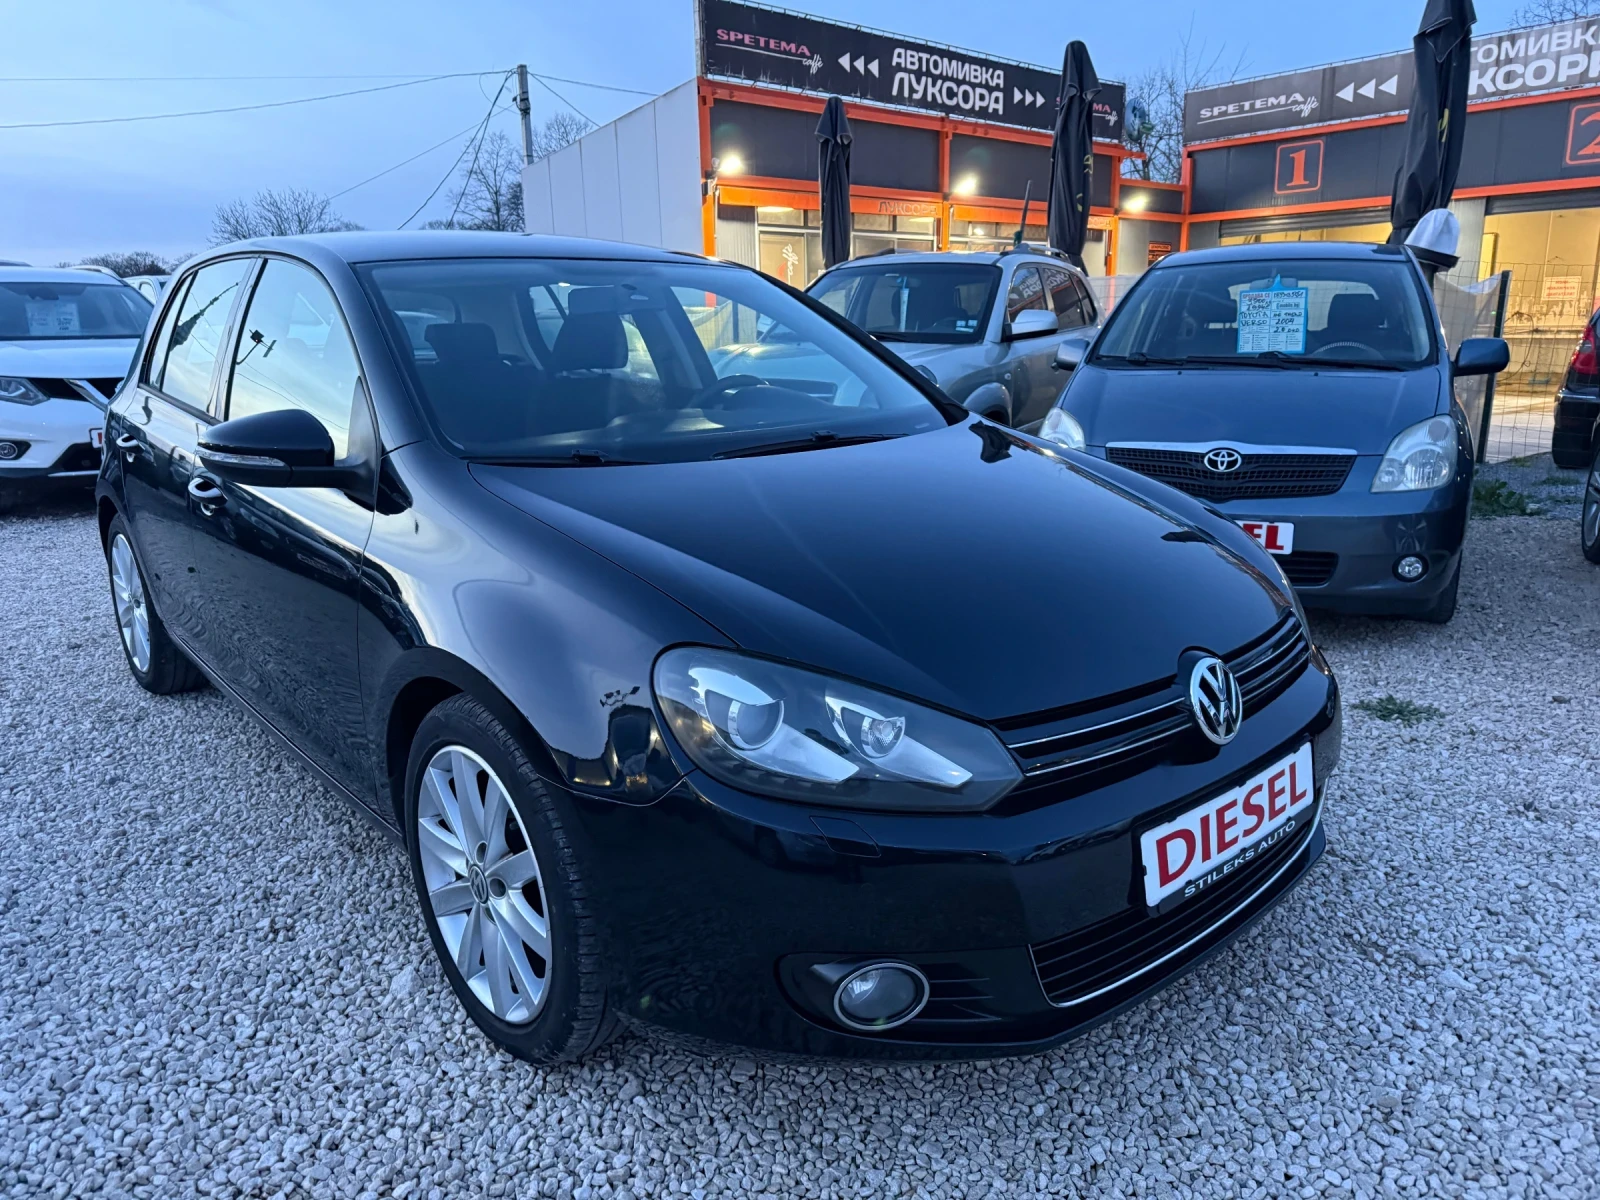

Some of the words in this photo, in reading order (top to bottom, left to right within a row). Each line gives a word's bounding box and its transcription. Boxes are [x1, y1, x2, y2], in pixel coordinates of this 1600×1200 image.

[716, 28, 812, 57] SPETEMA
[892, 47, 1004, 88] АВТОМИВКА
[891, 71, 1004, 115] ЛУКСОРА
[1199, 92, 1305, 119] SPETEMA
[1577, 110, 1600, 156] 2
[1286, 149, 1310, 188] 1
[1239, 311, 1269, 319] TOYOTA
[1155, 761, 1308, 889] DIESEL
[1184, 848, 1255, 898] STILEKS
[1257, 819, 1297, 853] AUTO
